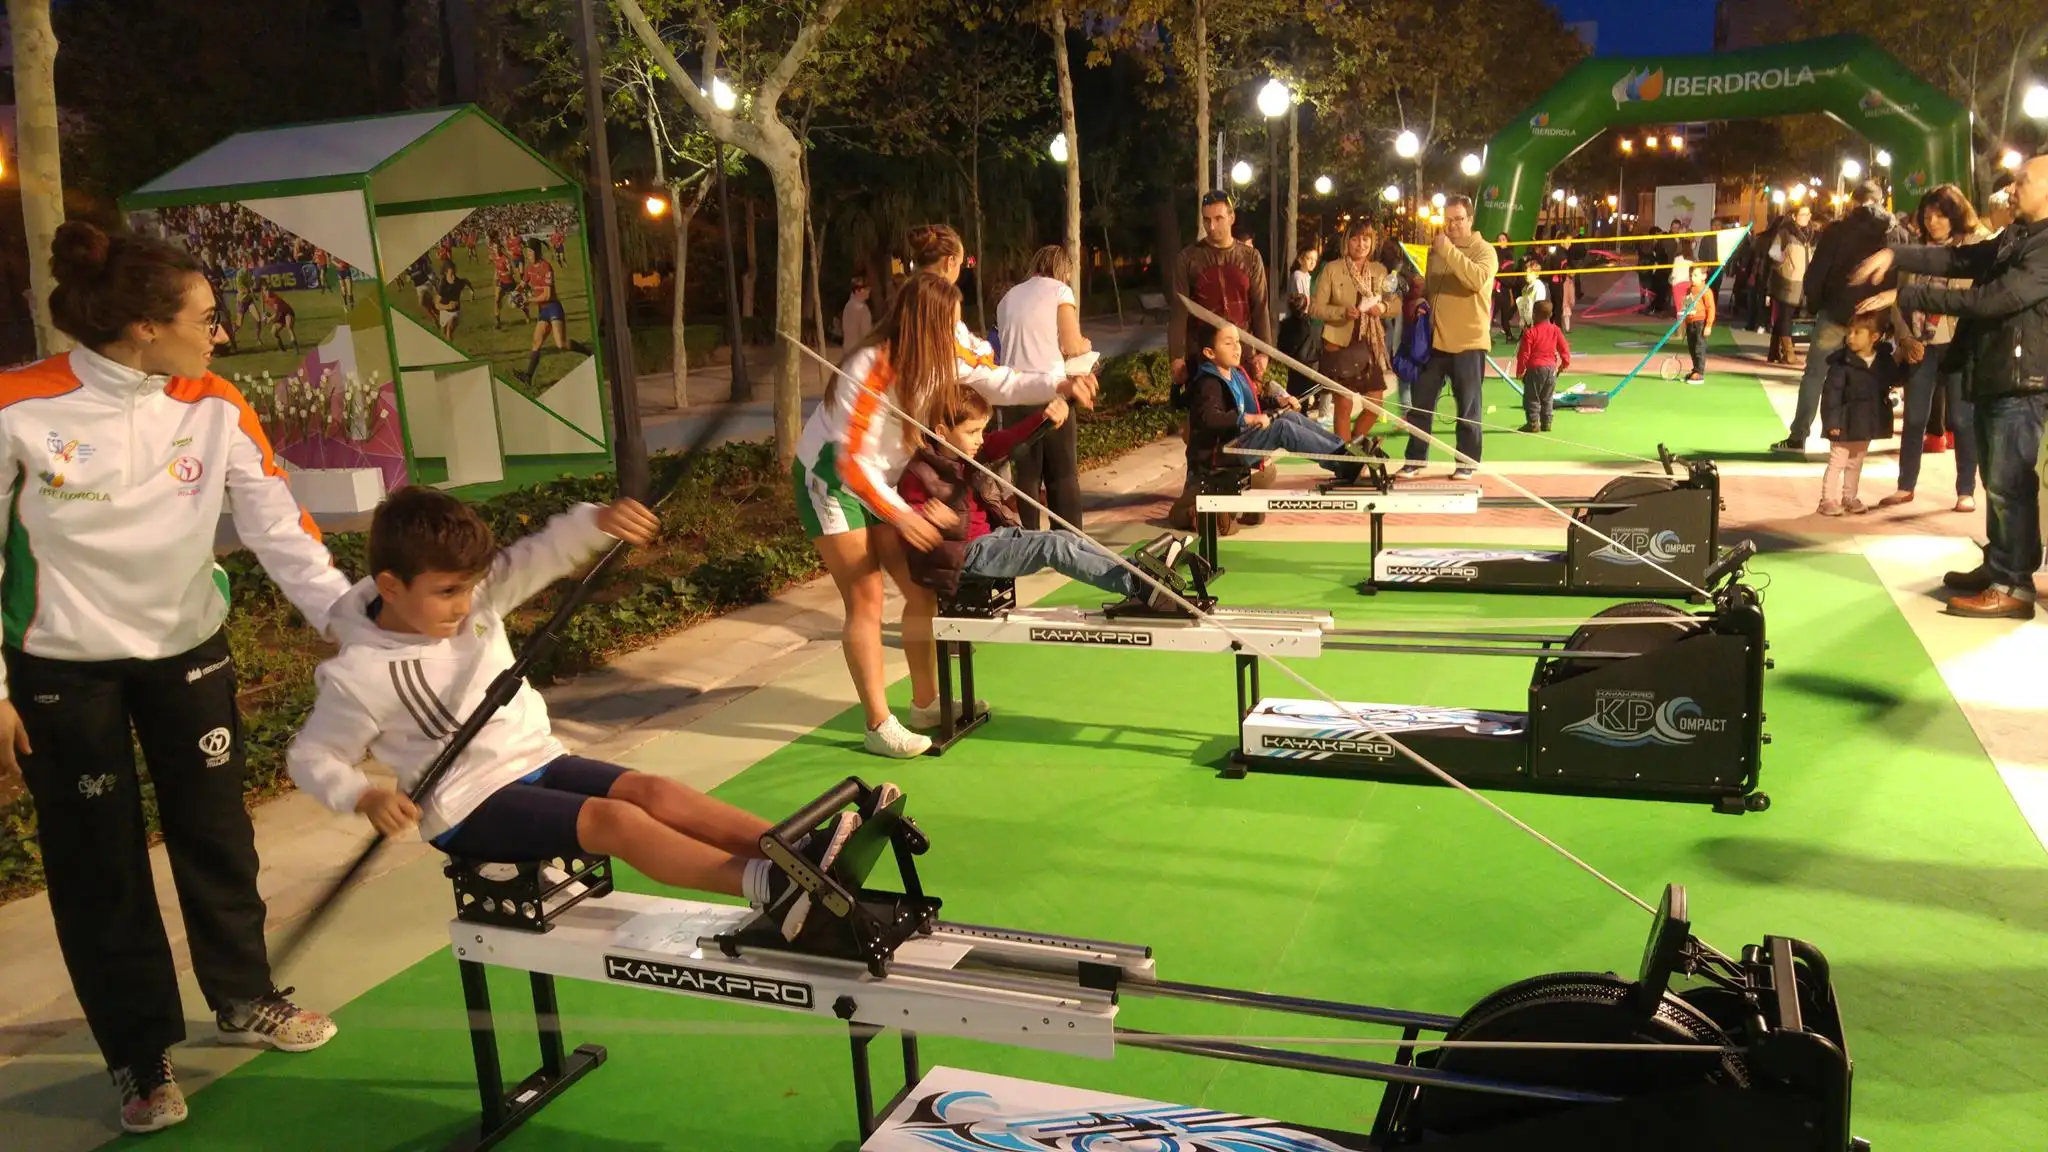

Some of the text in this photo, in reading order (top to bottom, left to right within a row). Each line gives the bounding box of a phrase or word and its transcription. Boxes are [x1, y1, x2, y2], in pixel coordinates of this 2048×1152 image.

[1665, 65, 1815, 97] IBERDROLA
[1531, 127, 1577, 136] IBERDROLA
[1269, 501, 1357, 510] KAYAKPRO
[1387, 566, 1477, 577] KAYAKPRO
[1031, 628, 1150, 645] KAYAKPRO
[1263, 736, 1393, 756] KAYAKPRO
[607, 957, 808, 1004] KAYAKPRO
